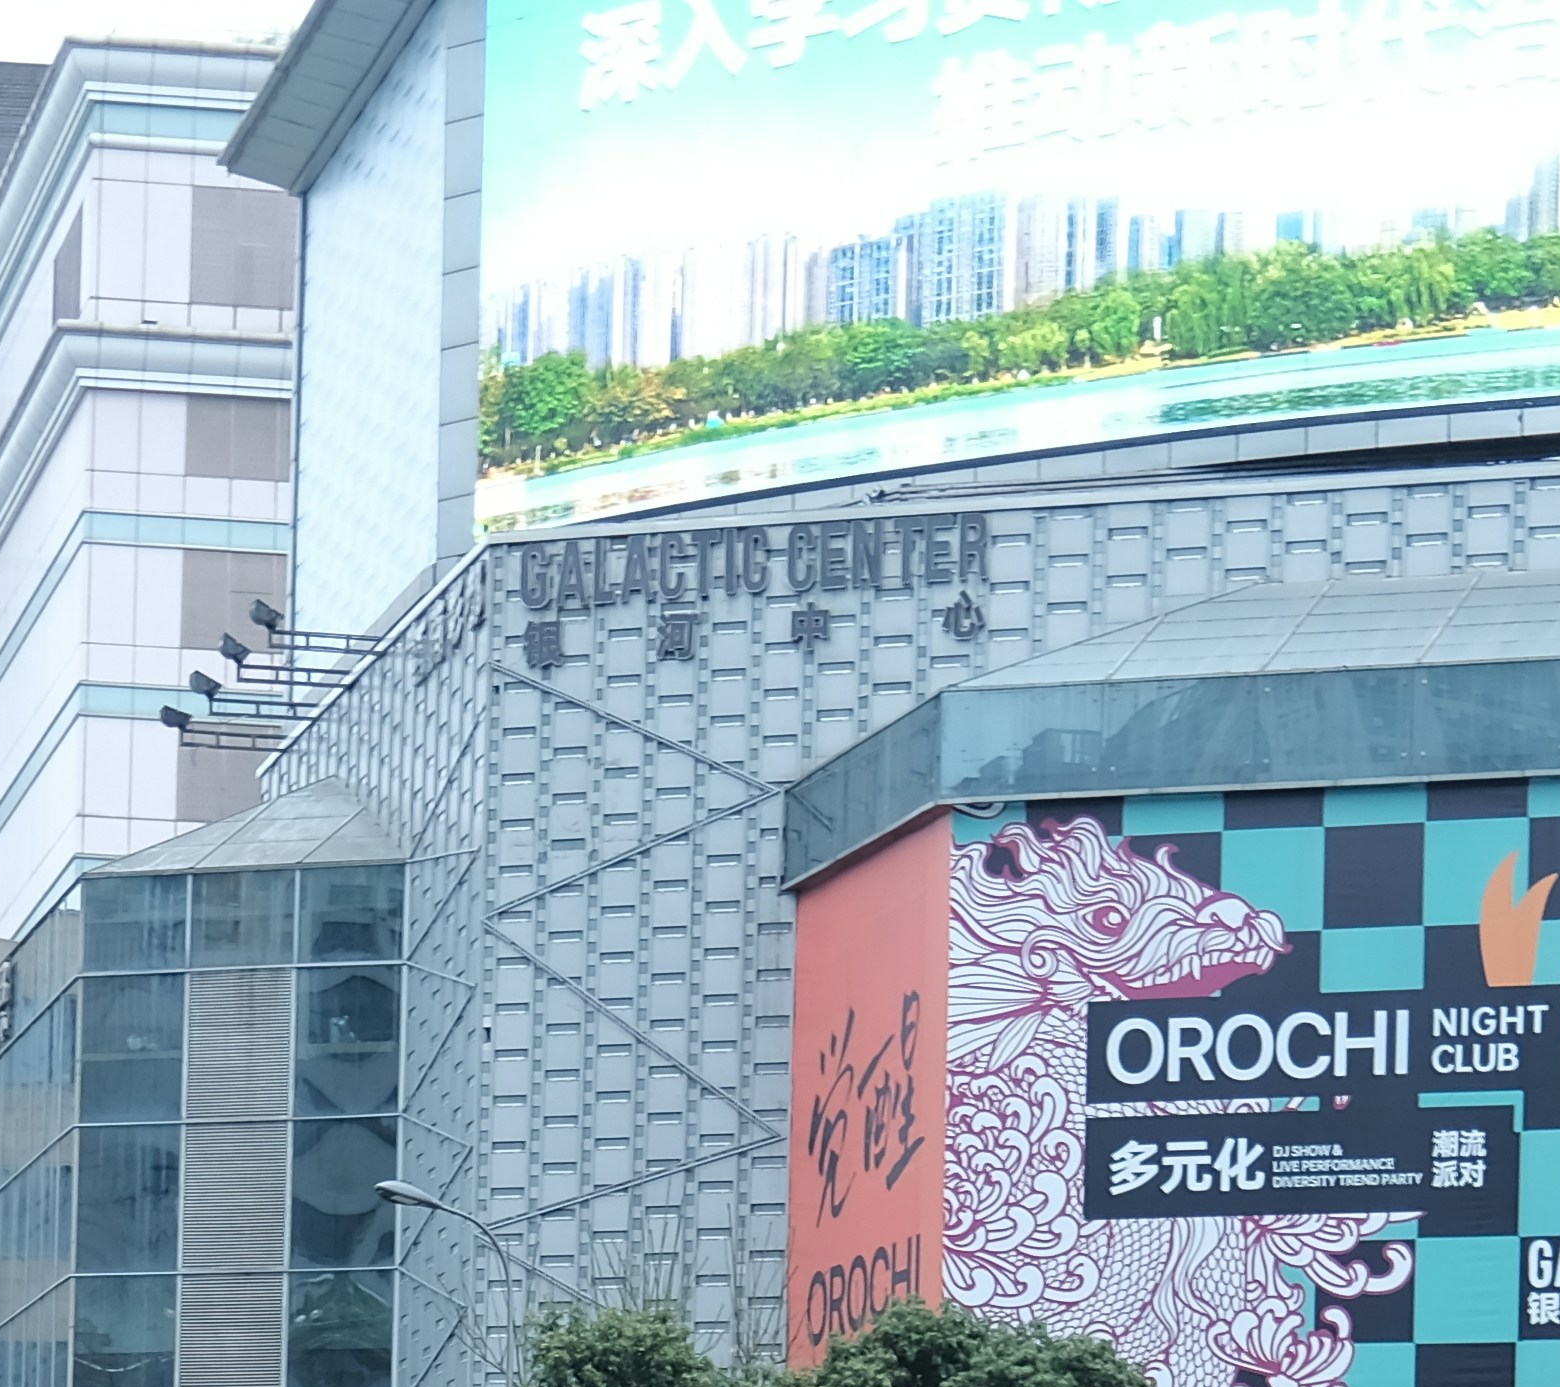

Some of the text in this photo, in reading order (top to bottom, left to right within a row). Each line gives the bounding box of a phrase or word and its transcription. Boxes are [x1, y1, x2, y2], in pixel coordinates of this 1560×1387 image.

[520, 513, 988, 610] GALACTIC CENTER
[523, 590, 984, 672] 银河中心
[1105, 1004, 1549, 1085] OROCHI NIGHT
[1430, 1043, 1521, 1073] CLUB
[1109, 1129, 1487, 1196] 多元化 潮流
[1272, 1144, 1343, 1158] DJ SHOW &
[1272, 1157, 1395, 1172] LIVE PERFORMANCE
[1431, 1160, 1487, 1188] 派对
[1272, 1172, 1423, 1188] DIVERSITY TREND PARTY
[807, 1233, 922, 1347] OROCHI
